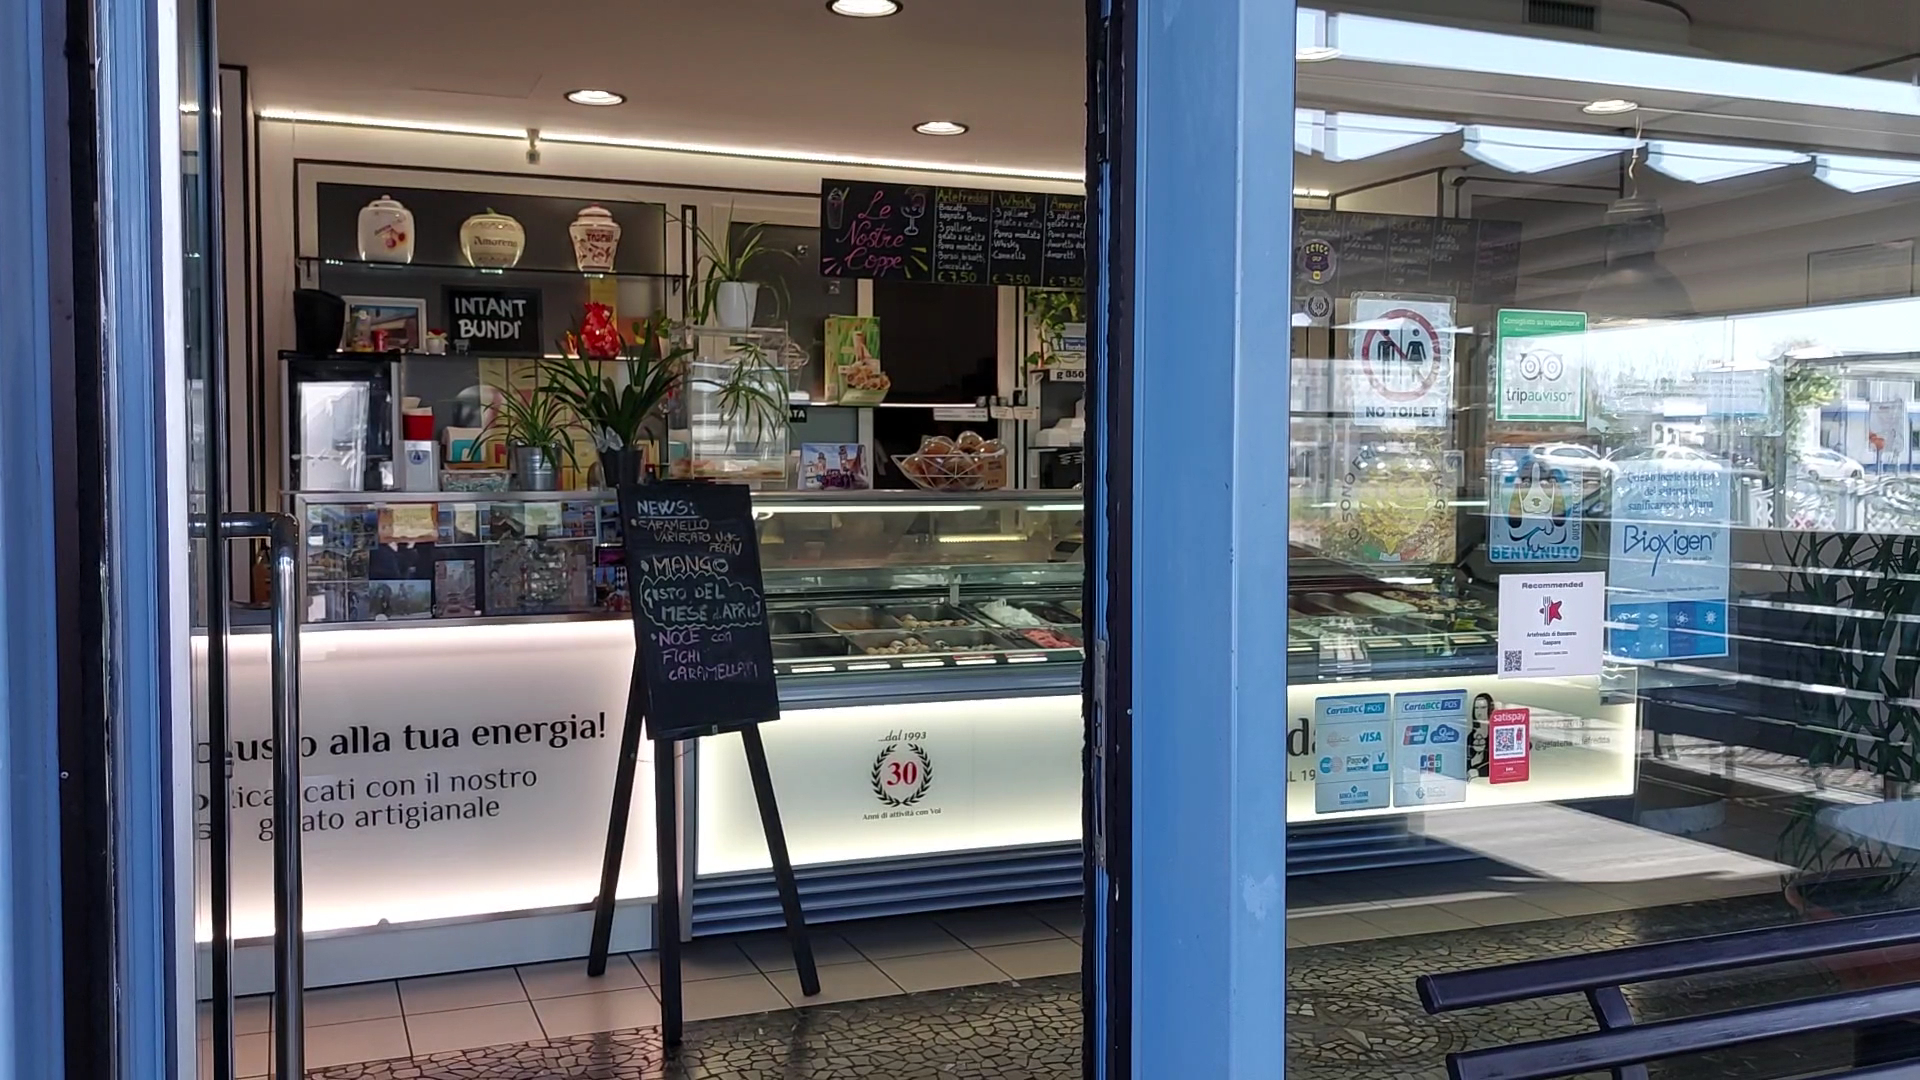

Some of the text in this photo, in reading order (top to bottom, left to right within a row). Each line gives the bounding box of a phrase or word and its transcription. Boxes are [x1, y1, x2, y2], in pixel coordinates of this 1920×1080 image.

[858, 190, 891, 220] Le
[995, 207, 1001, 217] 3
[1049, 211, 1054, 220] 3
[836, 220, 904, 248] Nostre
[939, 221, 945, 232] 3
[844, 248, 904, 277] Coppe
[455, 297, 526, 316] INTANT
[1506, 387, 1573, 404] tripadvisor
[1365, 406, 1439, 418] NO TOILET
[637, 500, 695, 516] NEWS:
[1491, 546, 1579, 560] BENVENUTO
[652, 555, 729, 577] MANGO
[694, 583, 726, 600] DEL
[1522, 581, 1584, 590] Recommended
[661, 604, 708, 622] MESE
[659, 627, 700, 647] NOCE
[663, 650, 700, 665] FICHI
[1326, 704, 1363, 715] CartaBCC
[1404, 700, 1459, 711] CartaBCC POS
[1493, 712, 1527, 723] satispay
[329, 725, 391, 756] alla
[402, 724, 460, 752] tua
[472, 712, 606, 748] energia!
[904, 731, 927, 741] 1993
[1359, 731, 1382, 743] VISA
[887, 761, 917, 786] 30
[1301, 769, 1316, 782] 19
[366, 775, 416, 798] con
[425, 772, 439, 794] il
[448, 767, 538, 793] nostro
[258, 797, 501, 842] gato artigianale
[915, 809, 929, 817] con
[930, 807, 941, 815] Voi
